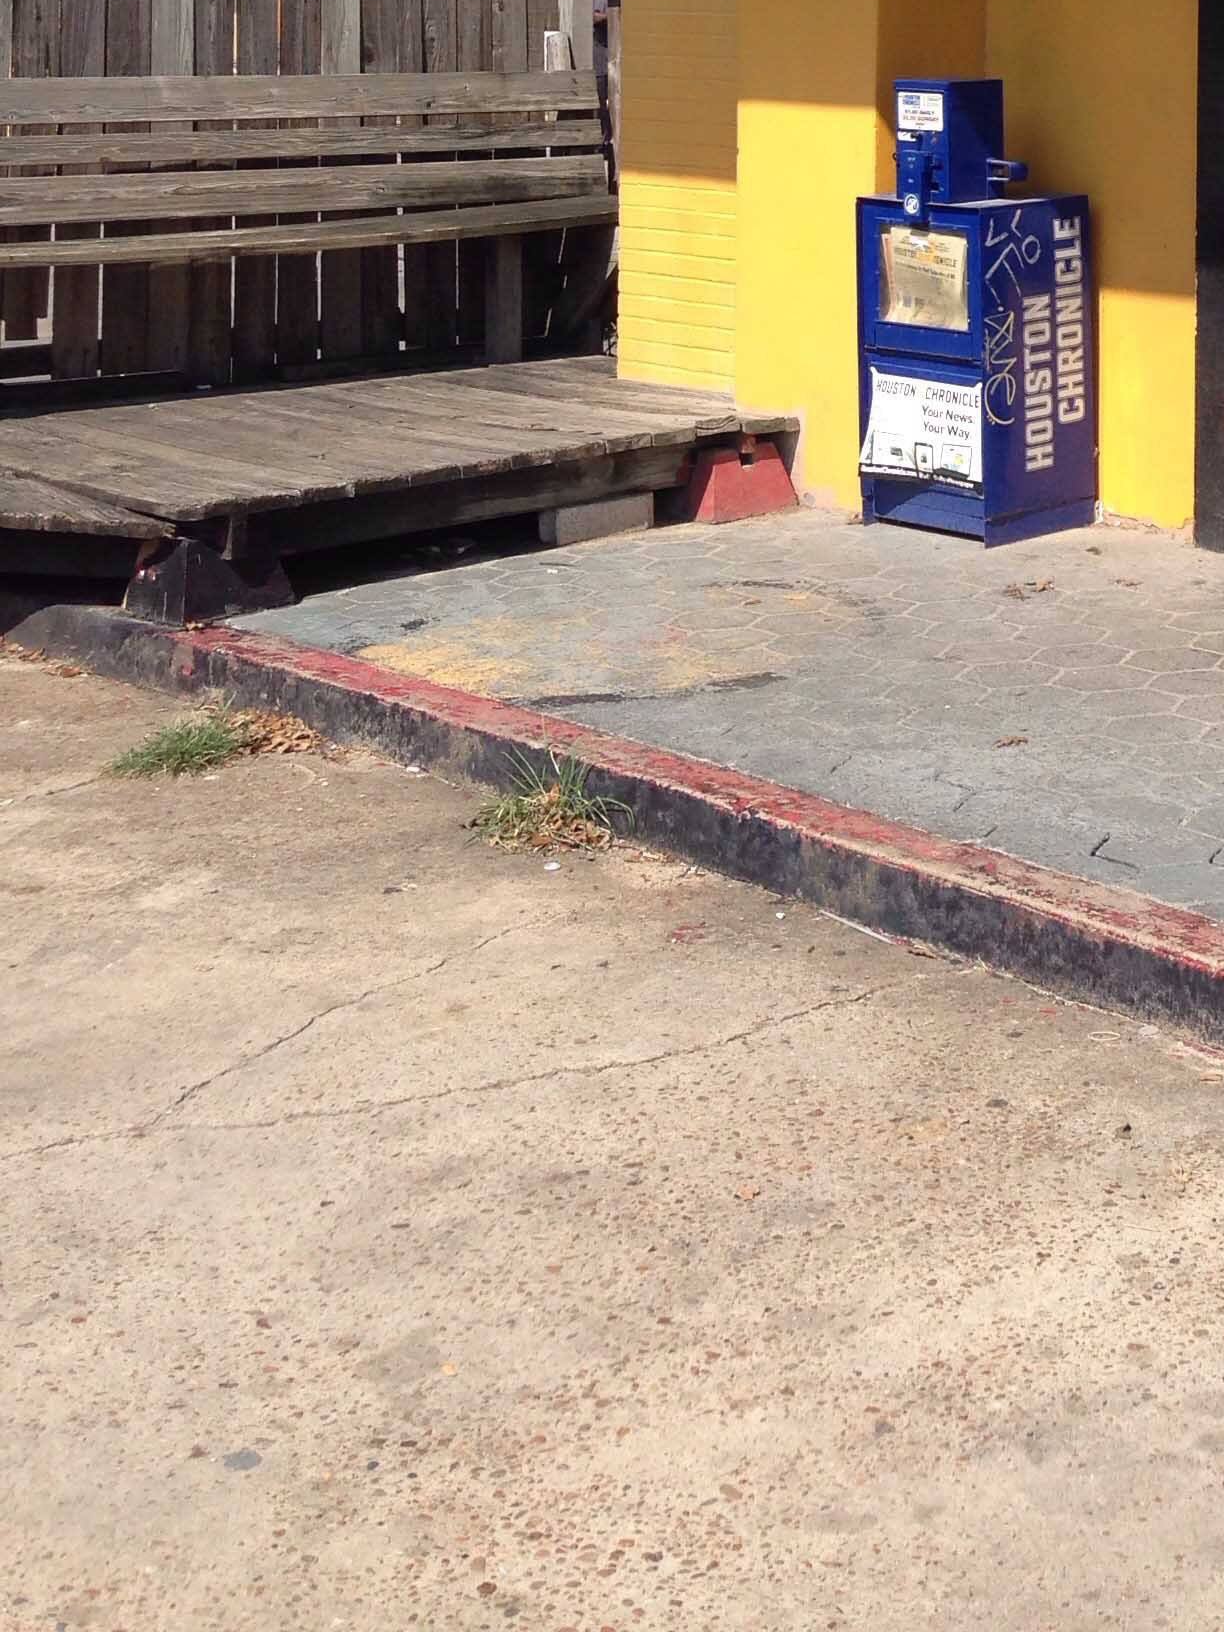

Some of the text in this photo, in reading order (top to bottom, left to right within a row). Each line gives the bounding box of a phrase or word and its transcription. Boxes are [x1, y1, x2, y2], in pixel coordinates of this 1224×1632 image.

[1052, 215, 1086, 425] CHRONICLE
[876, 379, 980, 408] HOUSTON CHRONICLE
[1022, 295, 1055, 473] HOUSTON
[922, 405, 943, 418] Your
[923, 421, 945, 434] Your
